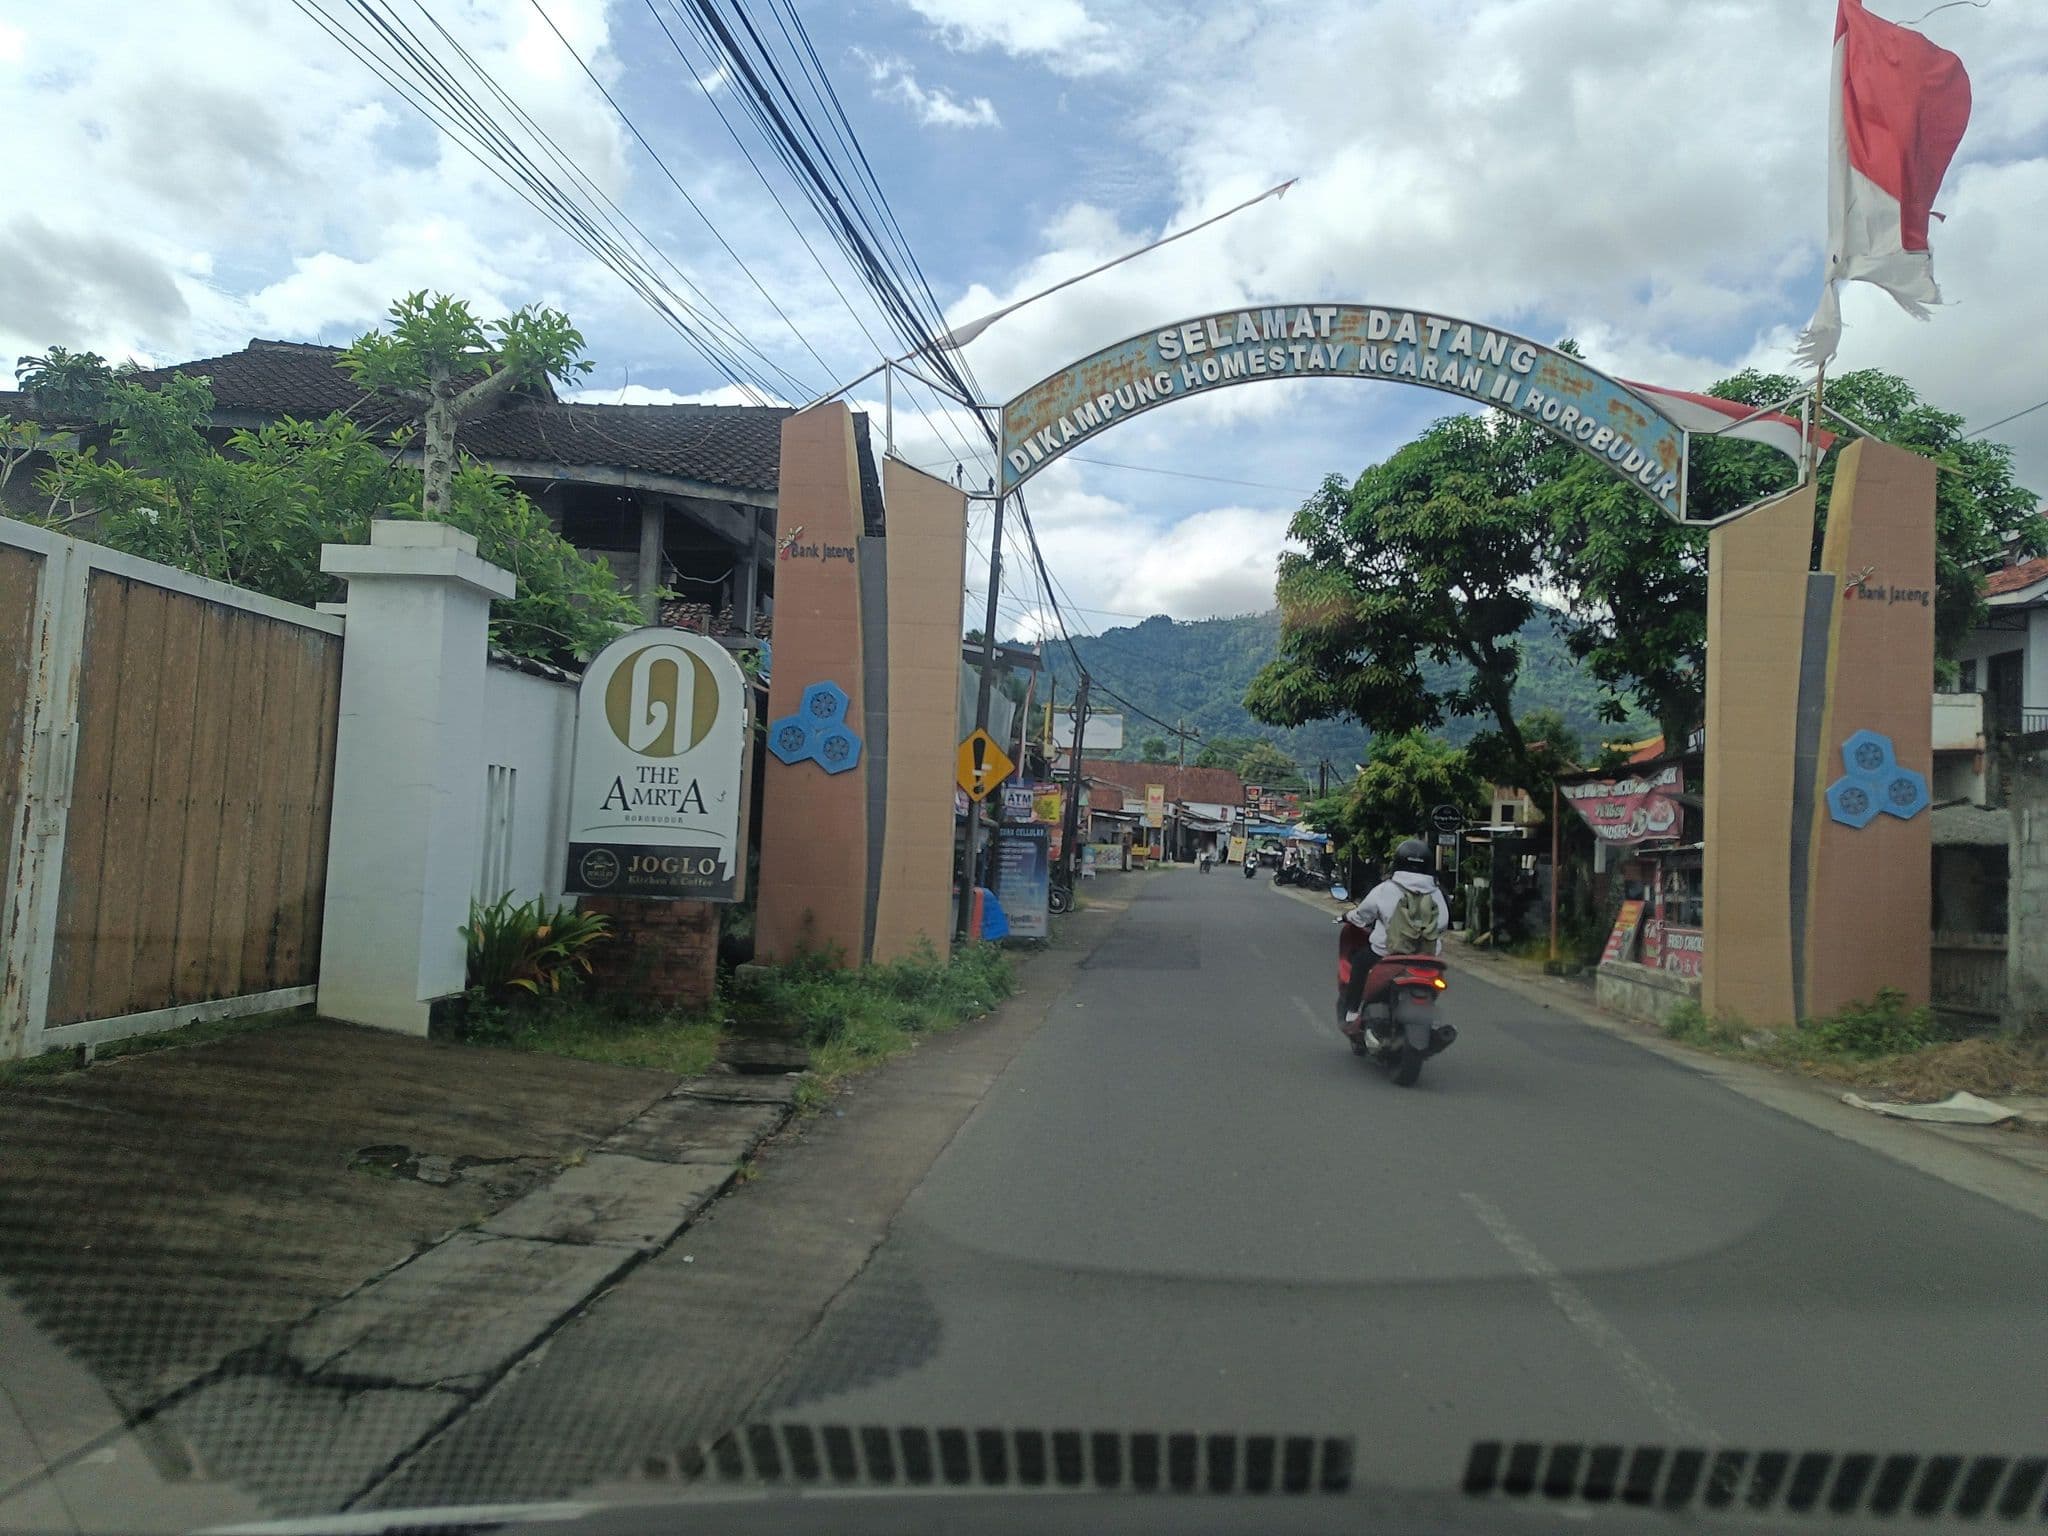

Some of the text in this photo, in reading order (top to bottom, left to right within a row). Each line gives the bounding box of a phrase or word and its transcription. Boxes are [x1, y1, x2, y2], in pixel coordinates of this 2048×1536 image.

[1157, 306, 1537, 375] SELAMAT DATANG
[1007, 344, 1678, 500] DIKAMPUNG HOMESTAY NGARAN II BOROBUDUR
[791, 541, 855, 563] Bank Jateng
[1888, 585, 1929, 607] Jateng
[636, 766, 679, 784] THE
[600, 775, 708, 814] AMRTA
[1007, 793, 1031, 803] ATM
[628, 855, 716, 876] JOGLO
